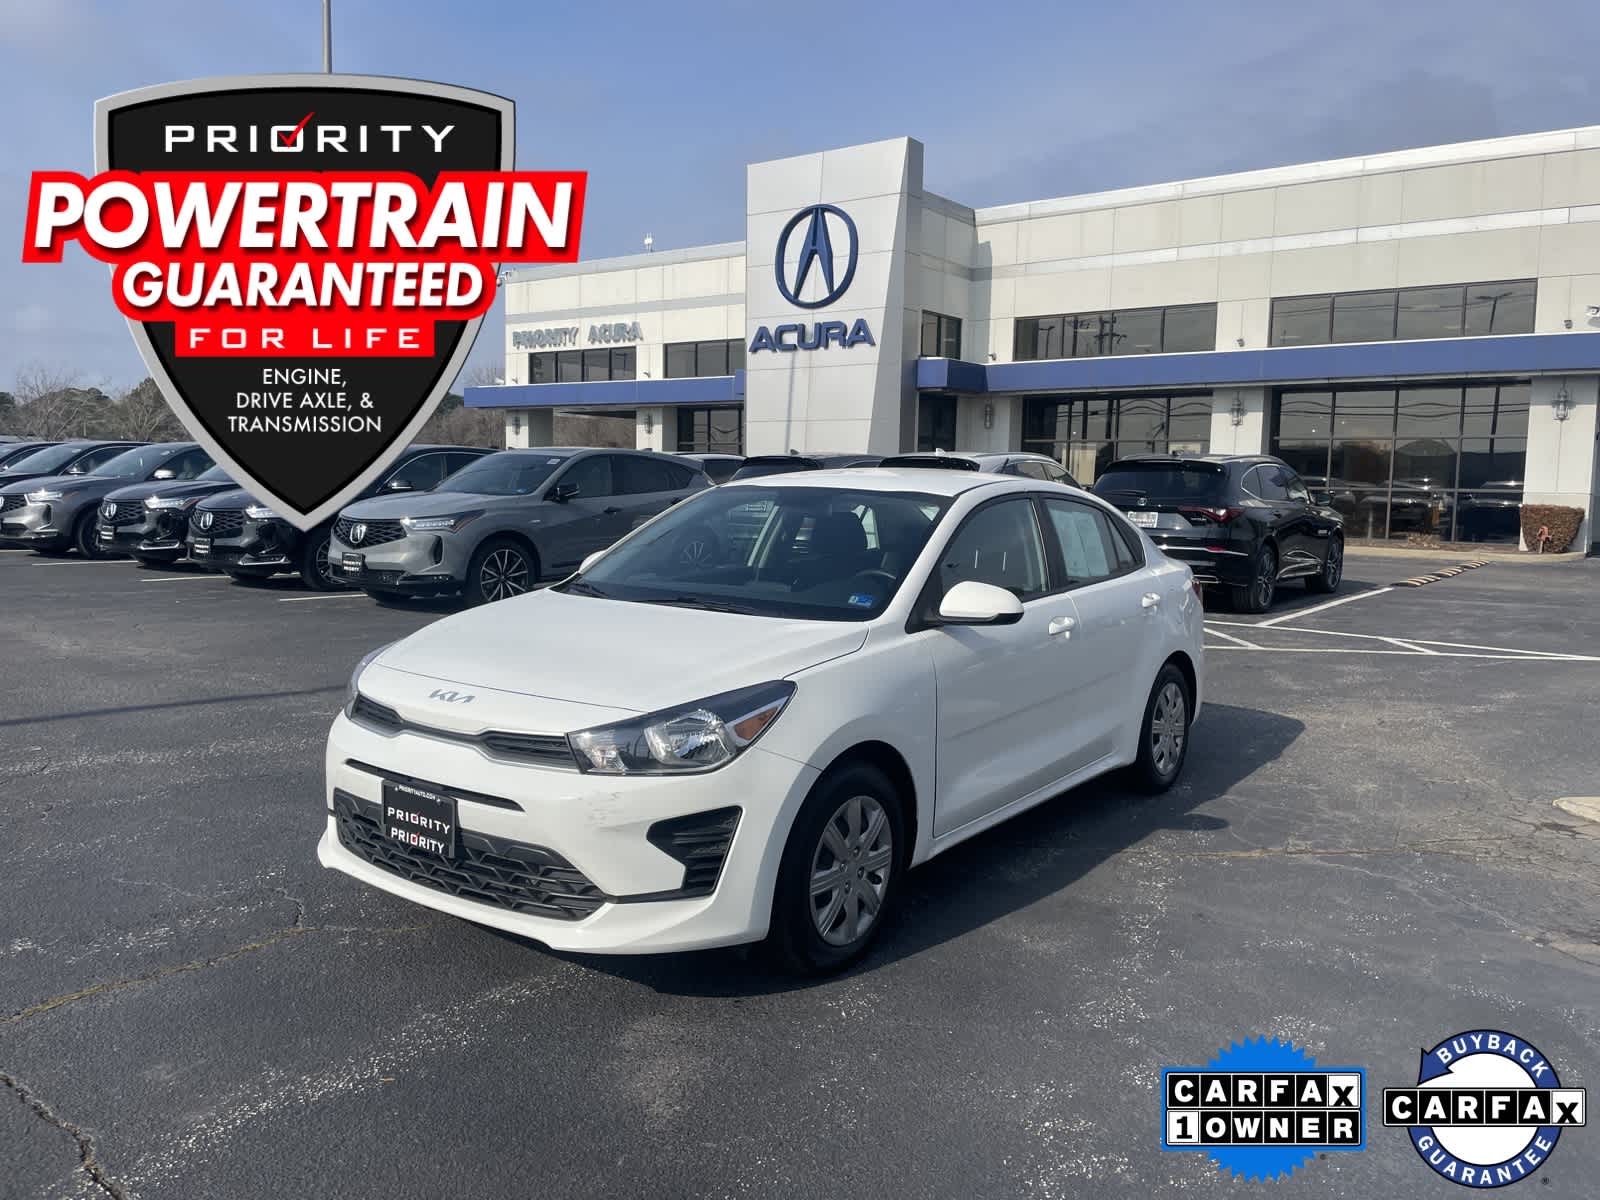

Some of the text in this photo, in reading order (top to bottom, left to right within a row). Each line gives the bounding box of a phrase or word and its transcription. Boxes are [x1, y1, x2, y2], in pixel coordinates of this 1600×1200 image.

[512, 321, 643, 349] PRIORITY ACURA
[749, 318, 876, 353] ACURA
[387, 806, 450, 834] PRIORITY
[391, 827, 444, 854] PRIORITY
